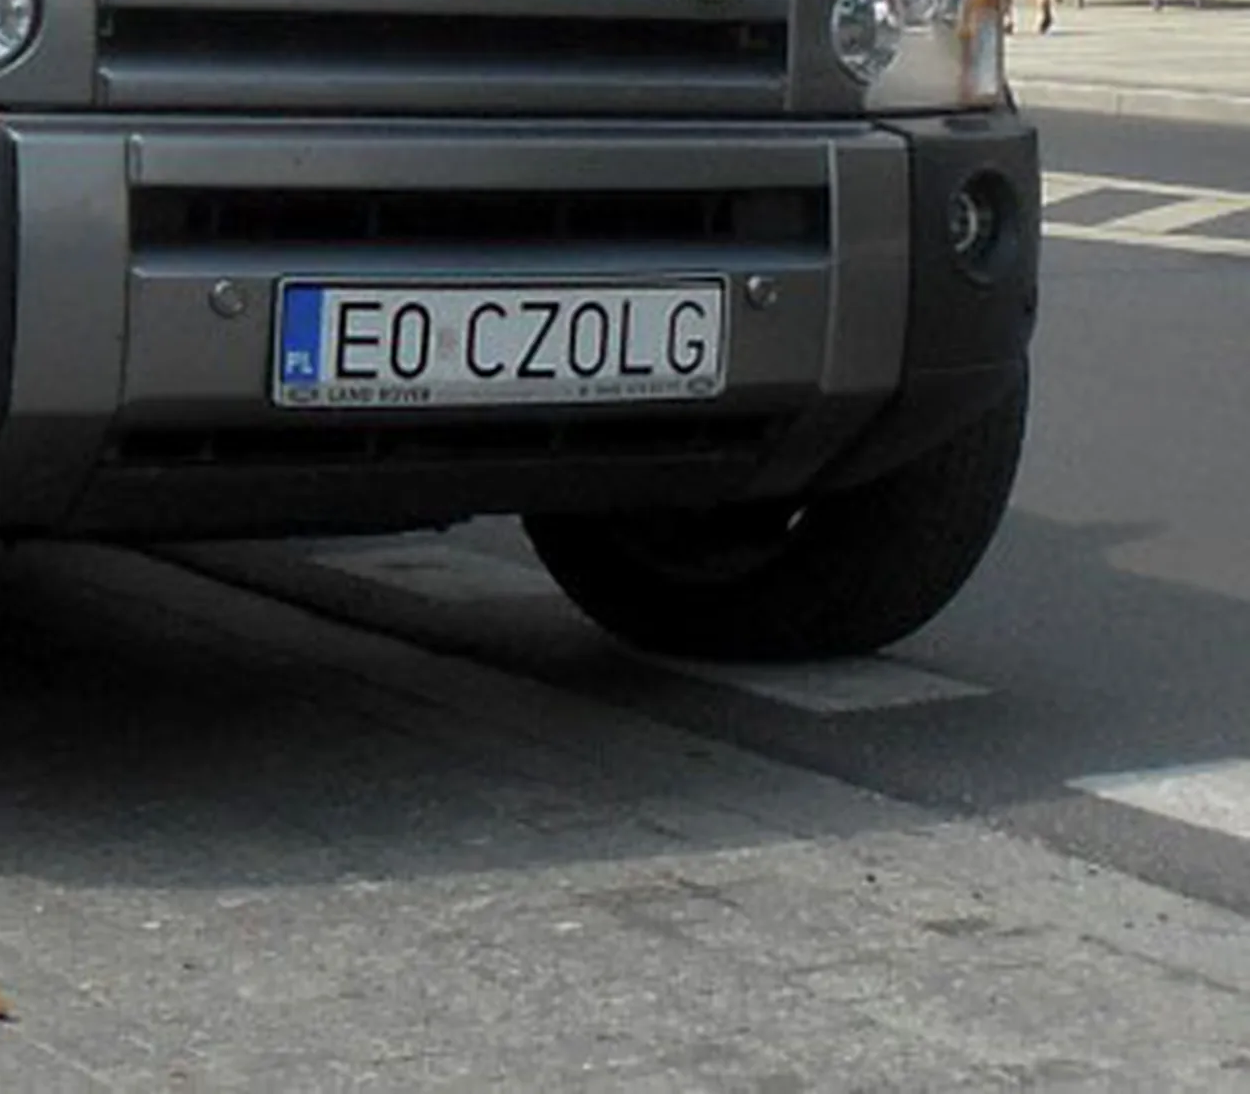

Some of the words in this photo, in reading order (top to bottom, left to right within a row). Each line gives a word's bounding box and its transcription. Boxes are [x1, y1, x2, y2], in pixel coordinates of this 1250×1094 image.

[465, 299, 707, 380] CZOLG
[285, 351, 313, 375] PL
[379, 386, 431, 402] ROVER
